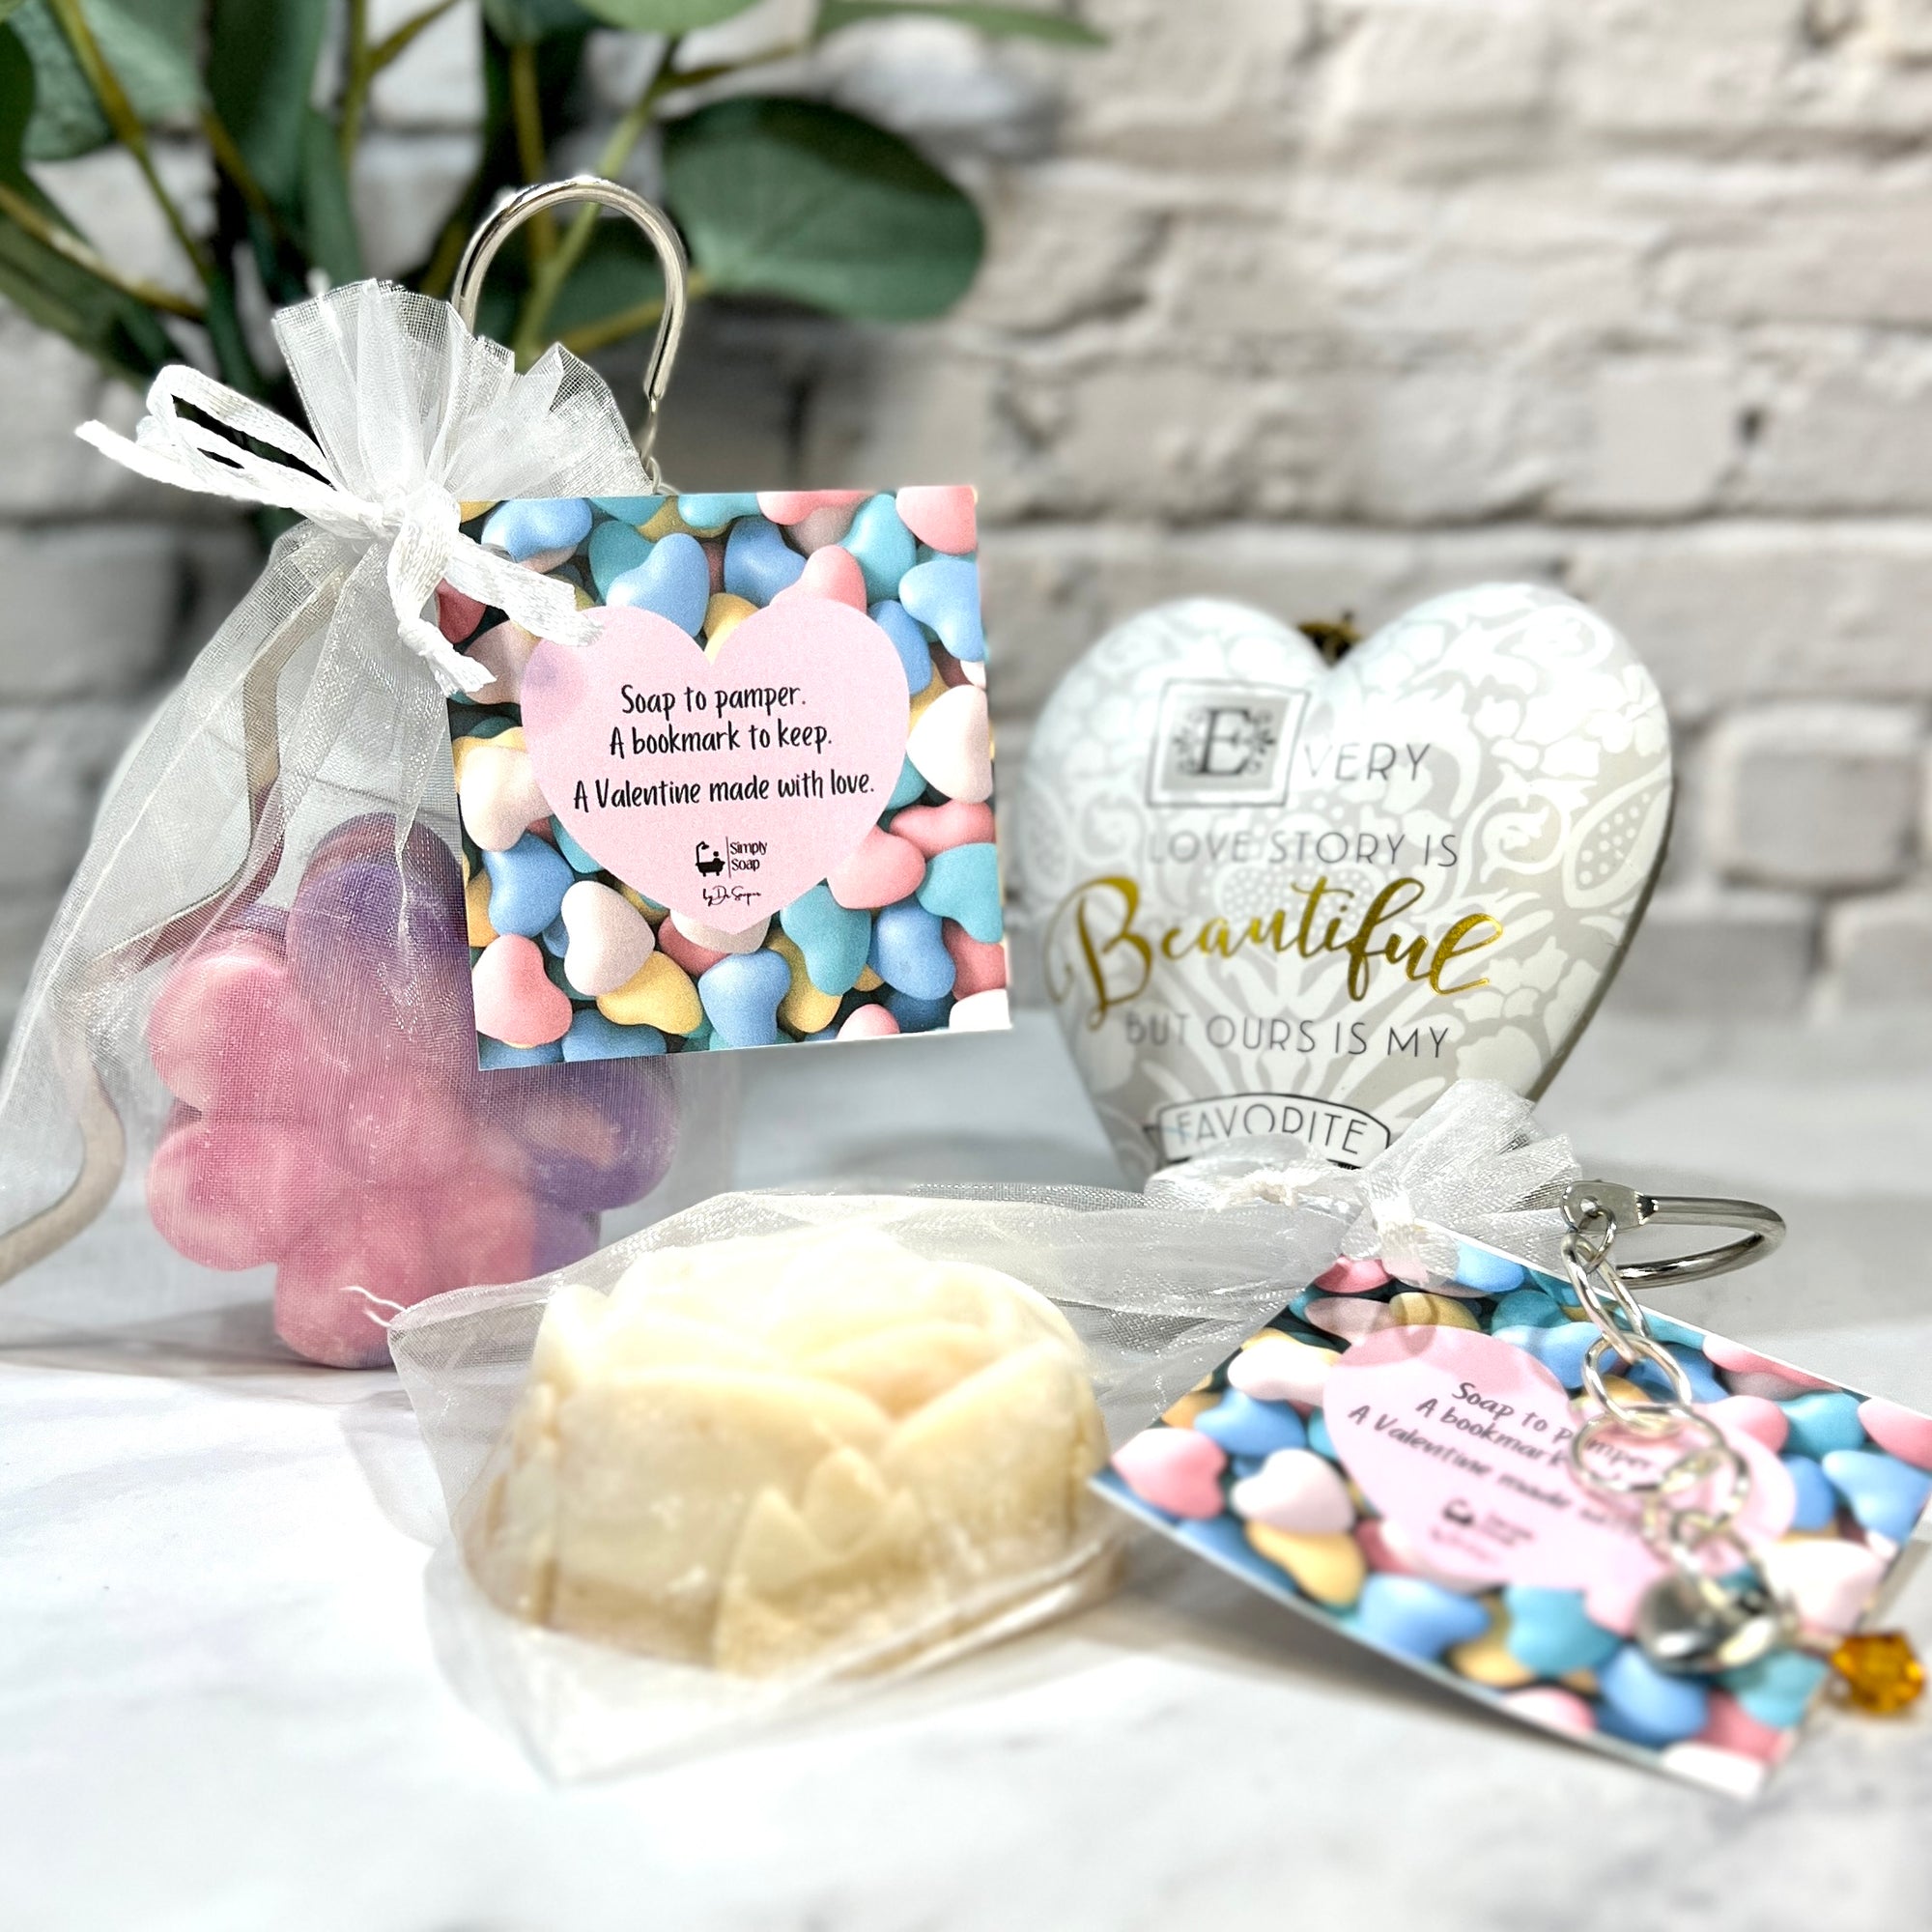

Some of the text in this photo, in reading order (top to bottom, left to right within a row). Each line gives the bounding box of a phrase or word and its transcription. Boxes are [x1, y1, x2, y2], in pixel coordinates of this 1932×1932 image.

[621, 684, 807, 721] Soap to pamper.
[610, 718, 833, 758] A bookmark to keep.
[573, 767, 875, 813] A Valentine made with love.
[729, 840, 768, 856] Simply
[731, 858, 760, 872] Soap
[1149, 831, 1459, 867] LOVE STORY IS
[1043, 875, 1504, 1032] Beautiful
[1126, 1011, 1451, 1059] BUT OURS IS MY
[1451, 1381, 1515, 1421] Soap
[1520, 1411, 1548, 1432] to
[1348, 1405, 1371, 1425] A
[1373, 1413, 1494, 1476] Valentine
[1415, 1397, 1569, 1466] A bookmark
